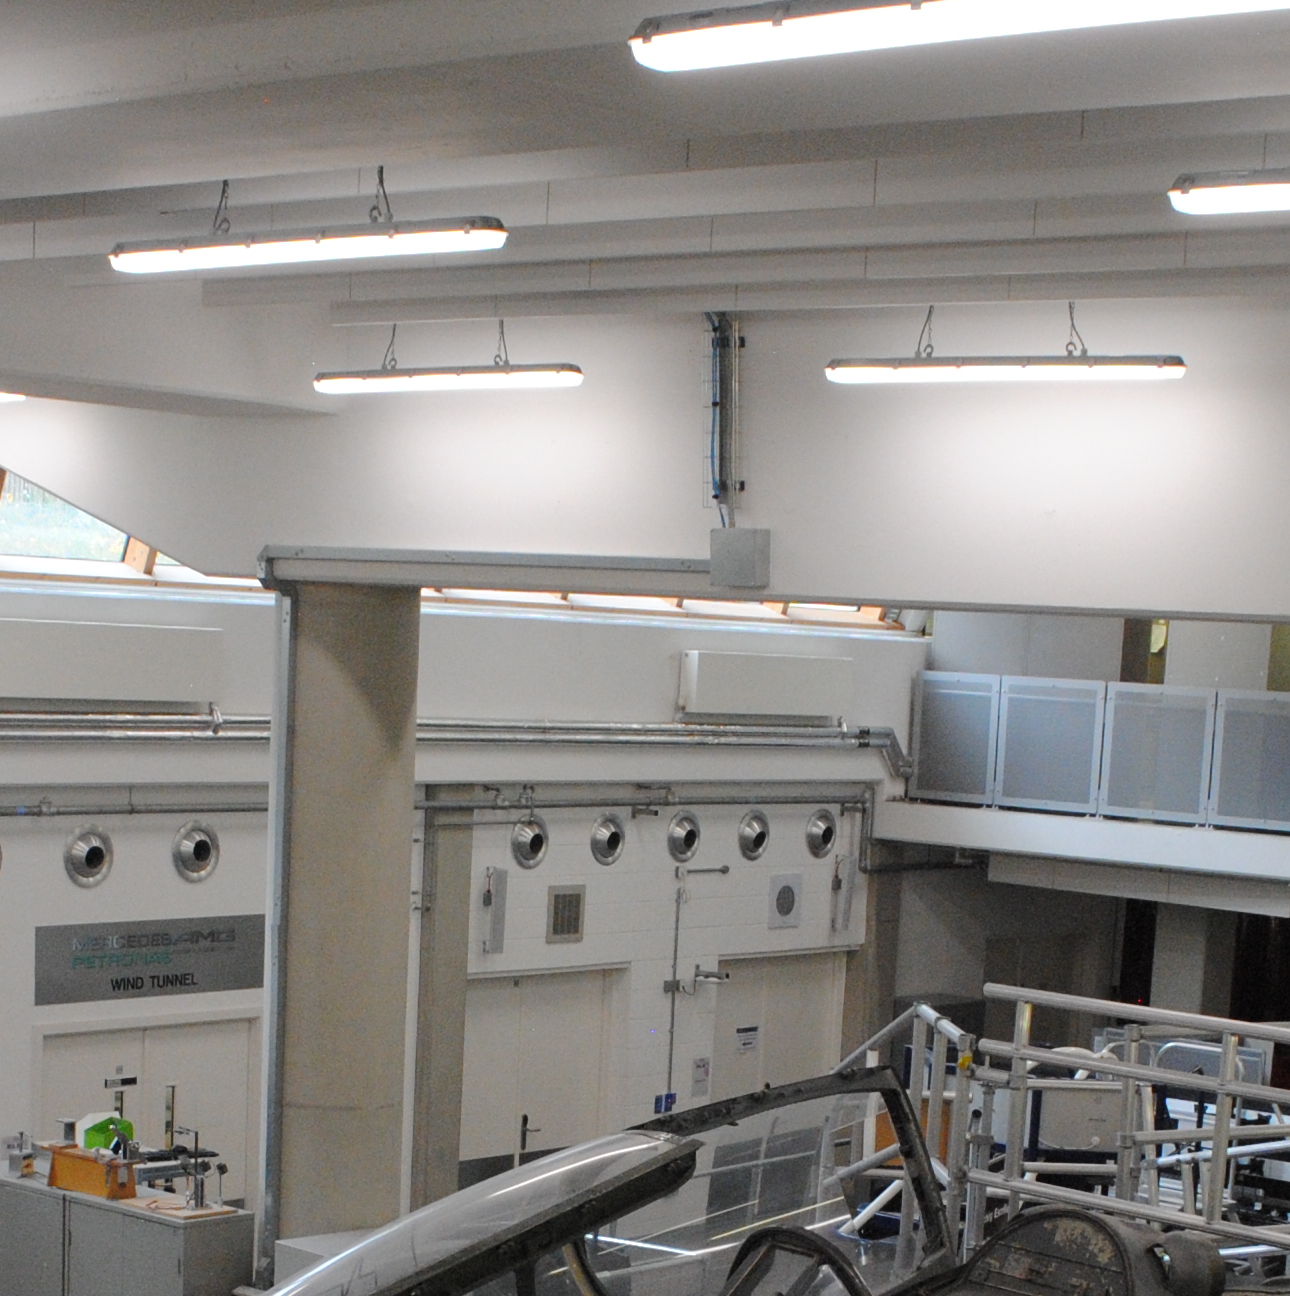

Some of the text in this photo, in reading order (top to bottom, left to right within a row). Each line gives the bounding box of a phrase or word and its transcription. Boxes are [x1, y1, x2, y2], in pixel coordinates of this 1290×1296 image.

[71, 950, 172, 969] PETRONAS
[111, 973, 198, 991] WIND TUNNEL
